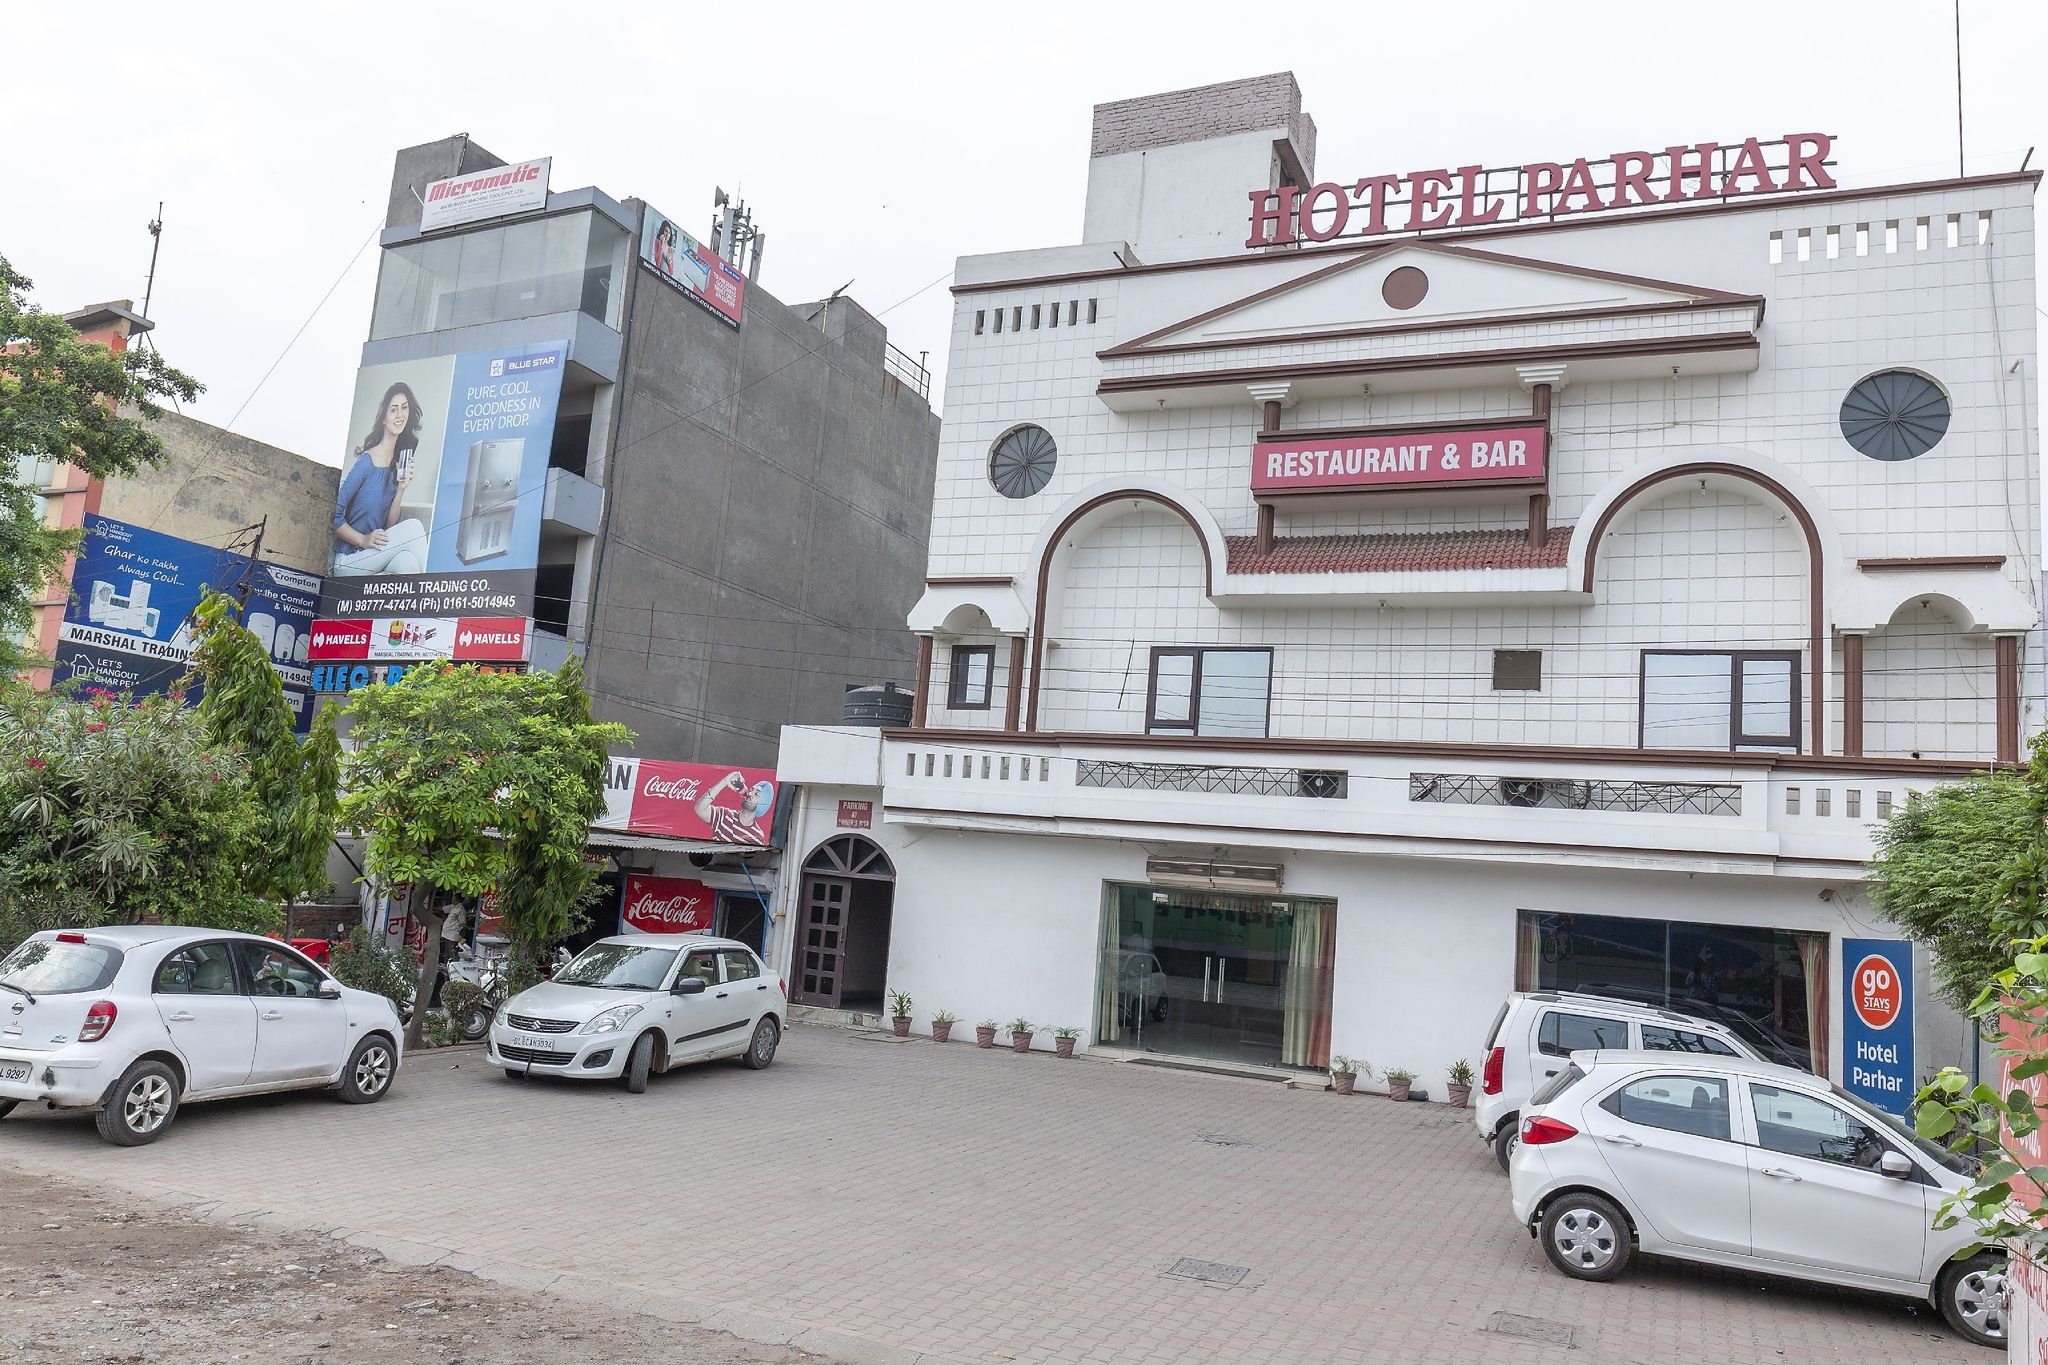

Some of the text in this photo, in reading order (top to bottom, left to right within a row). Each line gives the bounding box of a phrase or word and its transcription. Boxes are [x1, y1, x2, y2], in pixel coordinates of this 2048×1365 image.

[428, 164, 540, 202] Micromatic
[1246, 132, 1837, 248] HOTEL PARHAR
[509, 356, 555, 370] BLUE STAR
[468, 380, 531, 400] PURE, COOL
[466, 396, 540, 417] GOODNESS IN
[464, 414, 529, 432] EVERY DROP.
[1266, 440, 1526, 478] RESTAURANT & BAR
[104, 545, 136, 560] Ghar
[152, 559, 179, 572] Rakhe
[118, 564, 150, 578] Always
[275, 572, 317, 589] Crompton
[364, 579, 490, 595] MARSHAL TRADING CO.
[264, 590, 278, 599] the
[280, 593, 314, 608] Comfort
[337, 596, 515, 614] (M) 98777-47474 (Ph) 0161-5014945
[274, 602, 314, 618] & Warmth
[70, 628, 136, 650] MARSHAL
[326, 634, 367, 645] HAVELLS
[474, 632, 520, 644] HAVELLS
[97, 658, 122, 668] LET'S
[94, 676, 118, 685] GHAR
[96, 667, 139, 680] HANGOUT
[843, 801, 868, 811] PARKING
[1862, 969, 1890, 996] go
[1864, 997, 1890, 1010] STAYS
[1857, 1041, 1898, 1064] Hotel
[1853, 1067, 1903, 1092] Parhar
